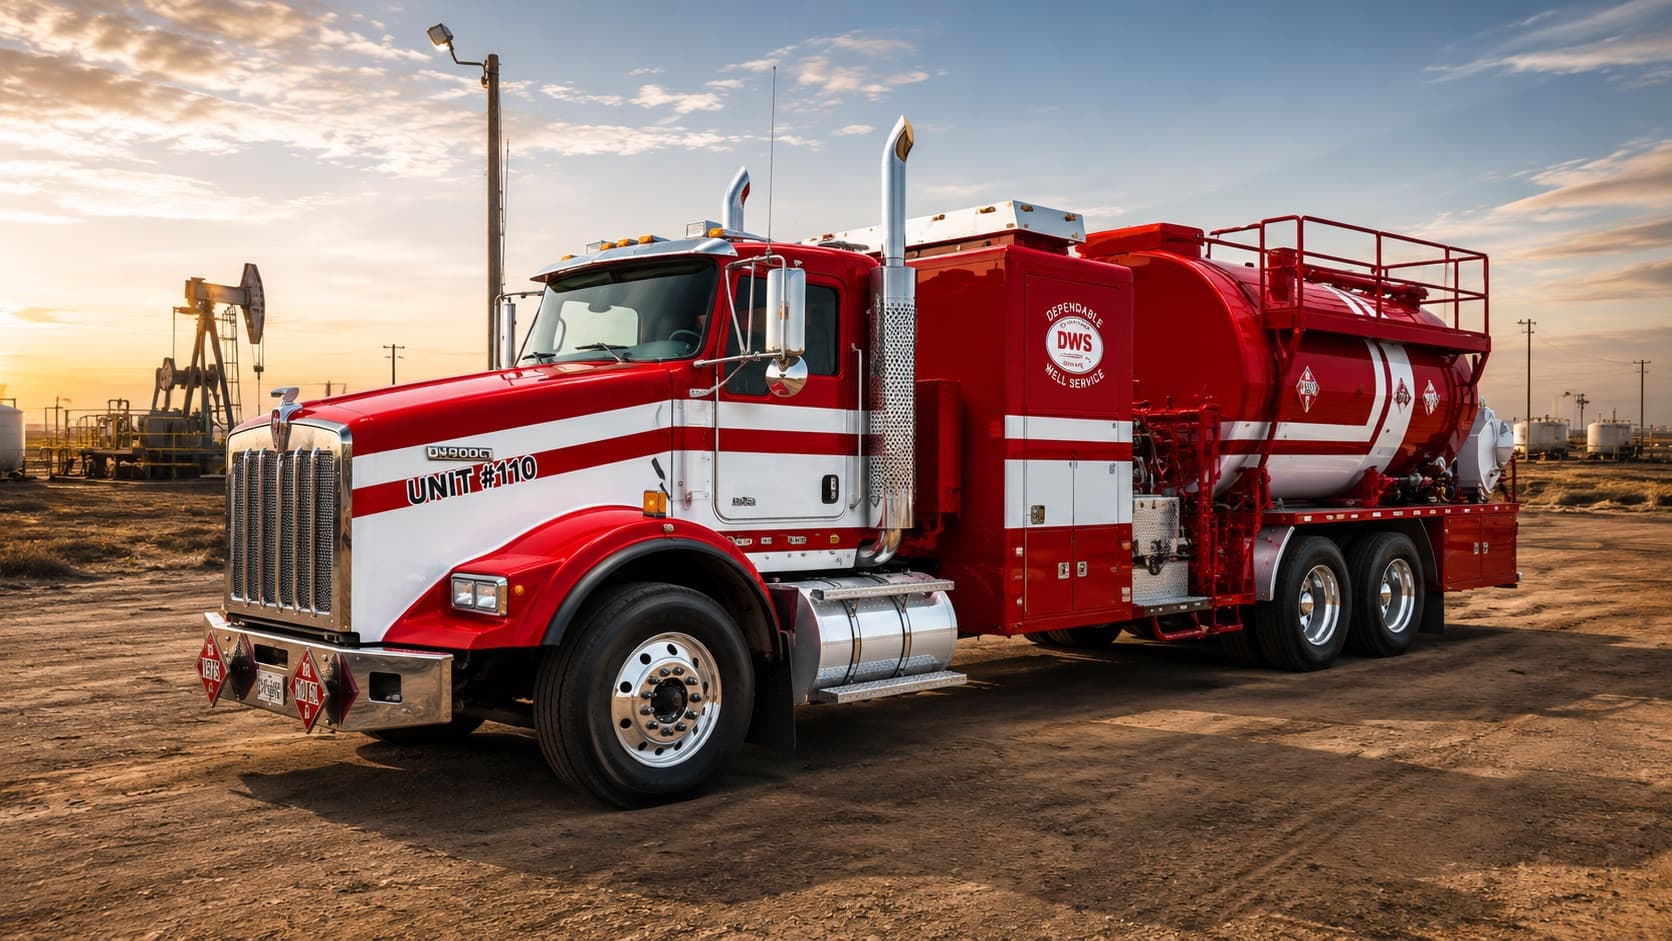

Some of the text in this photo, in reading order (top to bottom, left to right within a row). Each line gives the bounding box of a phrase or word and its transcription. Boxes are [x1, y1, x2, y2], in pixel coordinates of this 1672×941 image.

[1046, 302, 1103, 329] DEPENDABLE
[1057, 331, 1092, 352] DWS
[1045, 363, 1066, 386] WELL
[1069, 368, 1105, 389] SERVICE
[407, 455, 537, 505] UNIT #110
